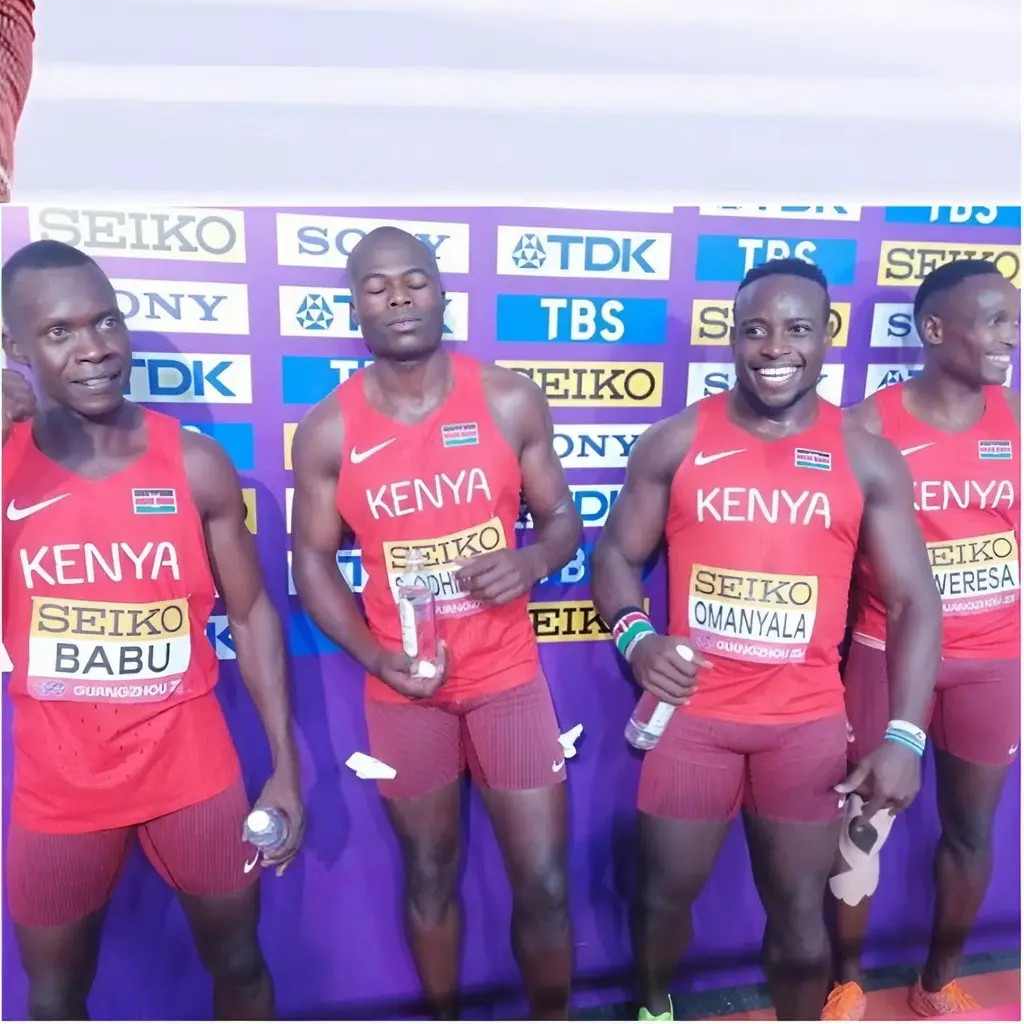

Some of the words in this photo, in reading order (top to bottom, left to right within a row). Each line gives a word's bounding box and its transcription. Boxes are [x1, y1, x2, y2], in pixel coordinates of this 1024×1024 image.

[38, 208, 236, 255] SEIKO
[547, 235, 656, 273] TDK
[541, 298, 625, 342] TBS
[366, 468, 492, 520] KENYA
[697, 487, 831, 529] KENYA
[20, 541, 180, 588] KENYA
[695, 570, 812, 606] SEIKO
[38, 603, 183, 637] SEIKO
[695, 600, 806, 639] OMANYALA
[55, 642, 171, 675] BABU
